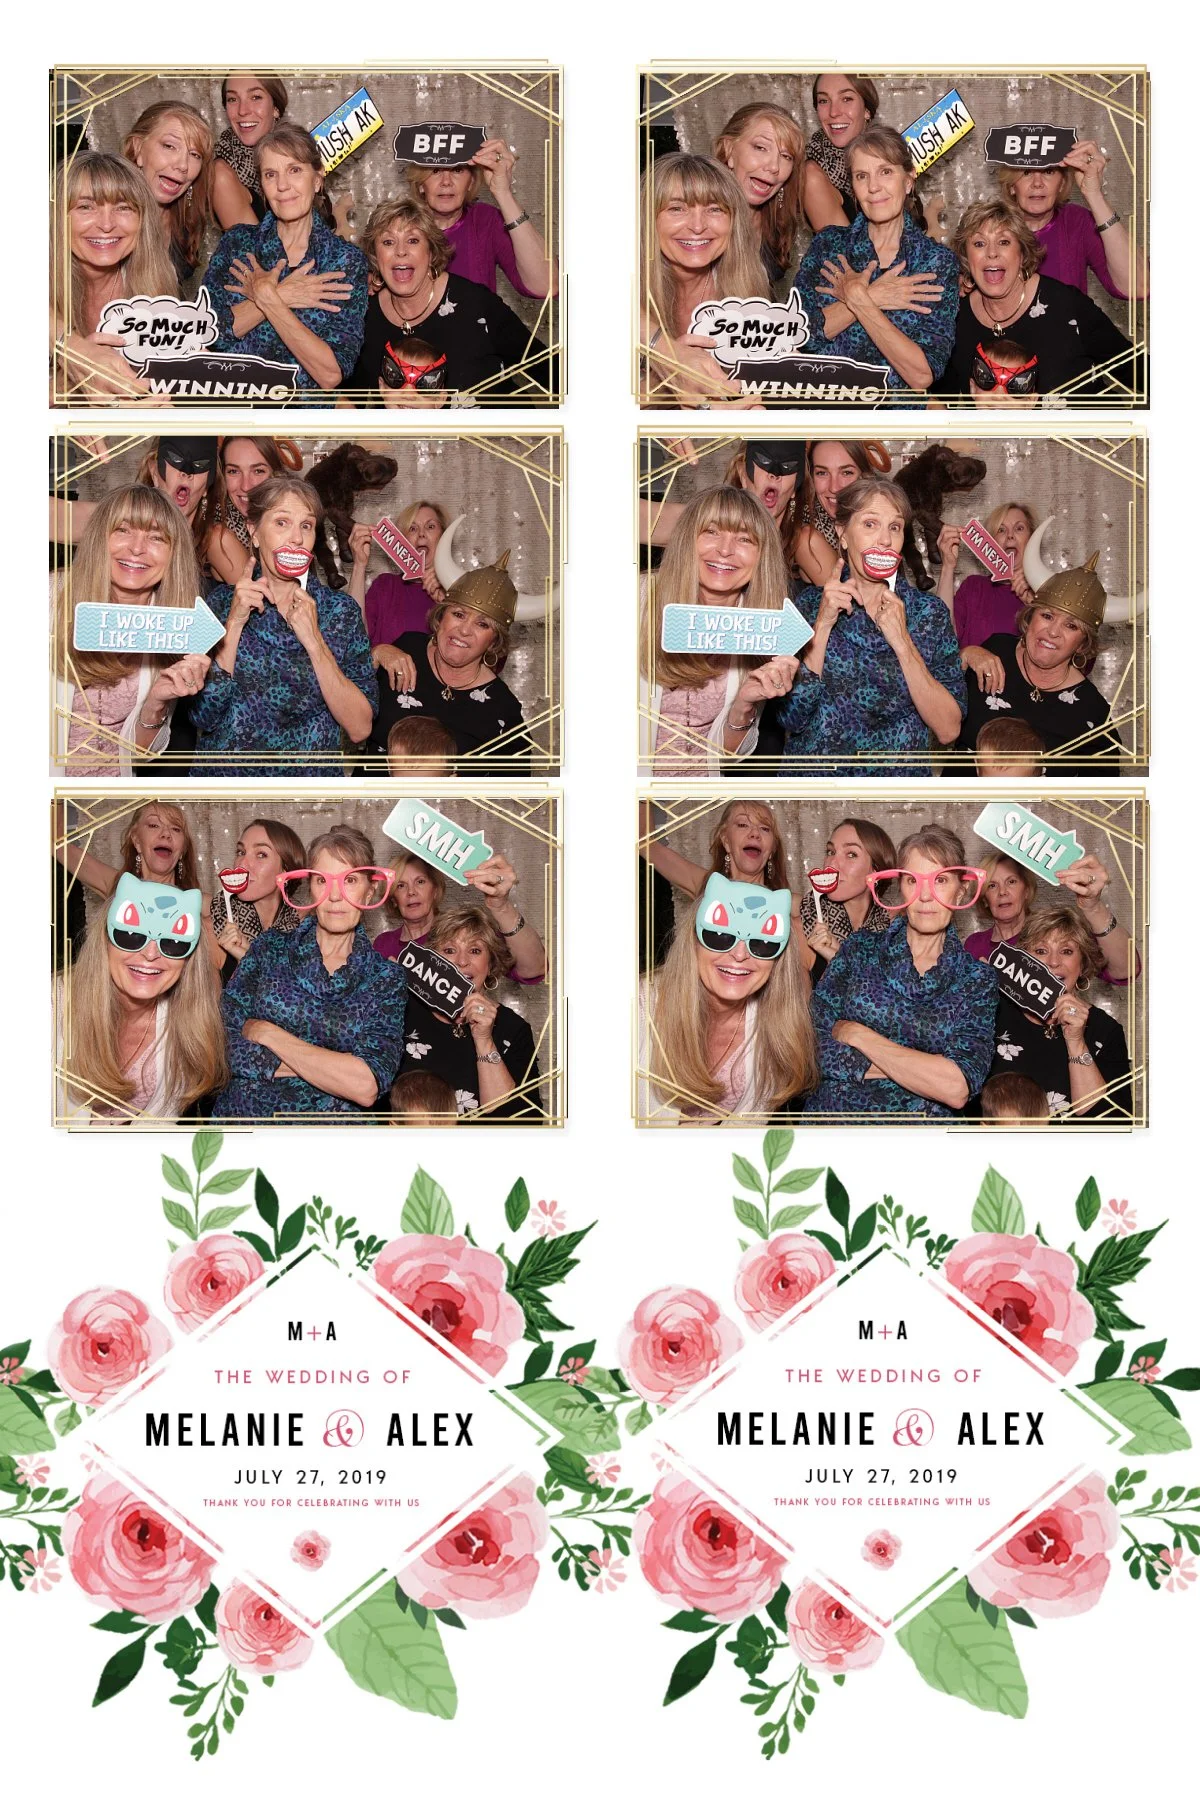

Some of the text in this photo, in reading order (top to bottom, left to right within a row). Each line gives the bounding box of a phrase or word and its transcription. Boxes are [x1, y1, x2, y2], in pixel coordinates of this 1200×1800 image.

[355, 101, 376, 132] AK
[945, 103, 967, 134] AK
[413, 133, 466, 154] BFF
[1004, 135, 1057, 156] BFF
[118, 317, 208, 335] SO MUCH
[709, 318, 799, 337] SO MUCH
[139, 334, 186, 350] FUN!
[730, 336, 777, 352] FUN!
[150, 378, 289, 401] WINNING
[741, 379, 880, 402] WINNING
[377, 524, 421, 574] I'M NEXT!
[966, 526, 1009, 575] I'M NEXT!
[100, 611, 194, 632] I WOKE UP
[687, 612, 782, 633] I WOKE UP
[99, 630, 189, 650] LIKE THIS!
[687, 632, 778, 651] LIKE THIS!
[405, 811, 475, 870] SMH
[998, 811, 1067, 870] SMH
[402, 952, 462, 1004] DANCE
[993, 953, 1054, 1005] DANCE
